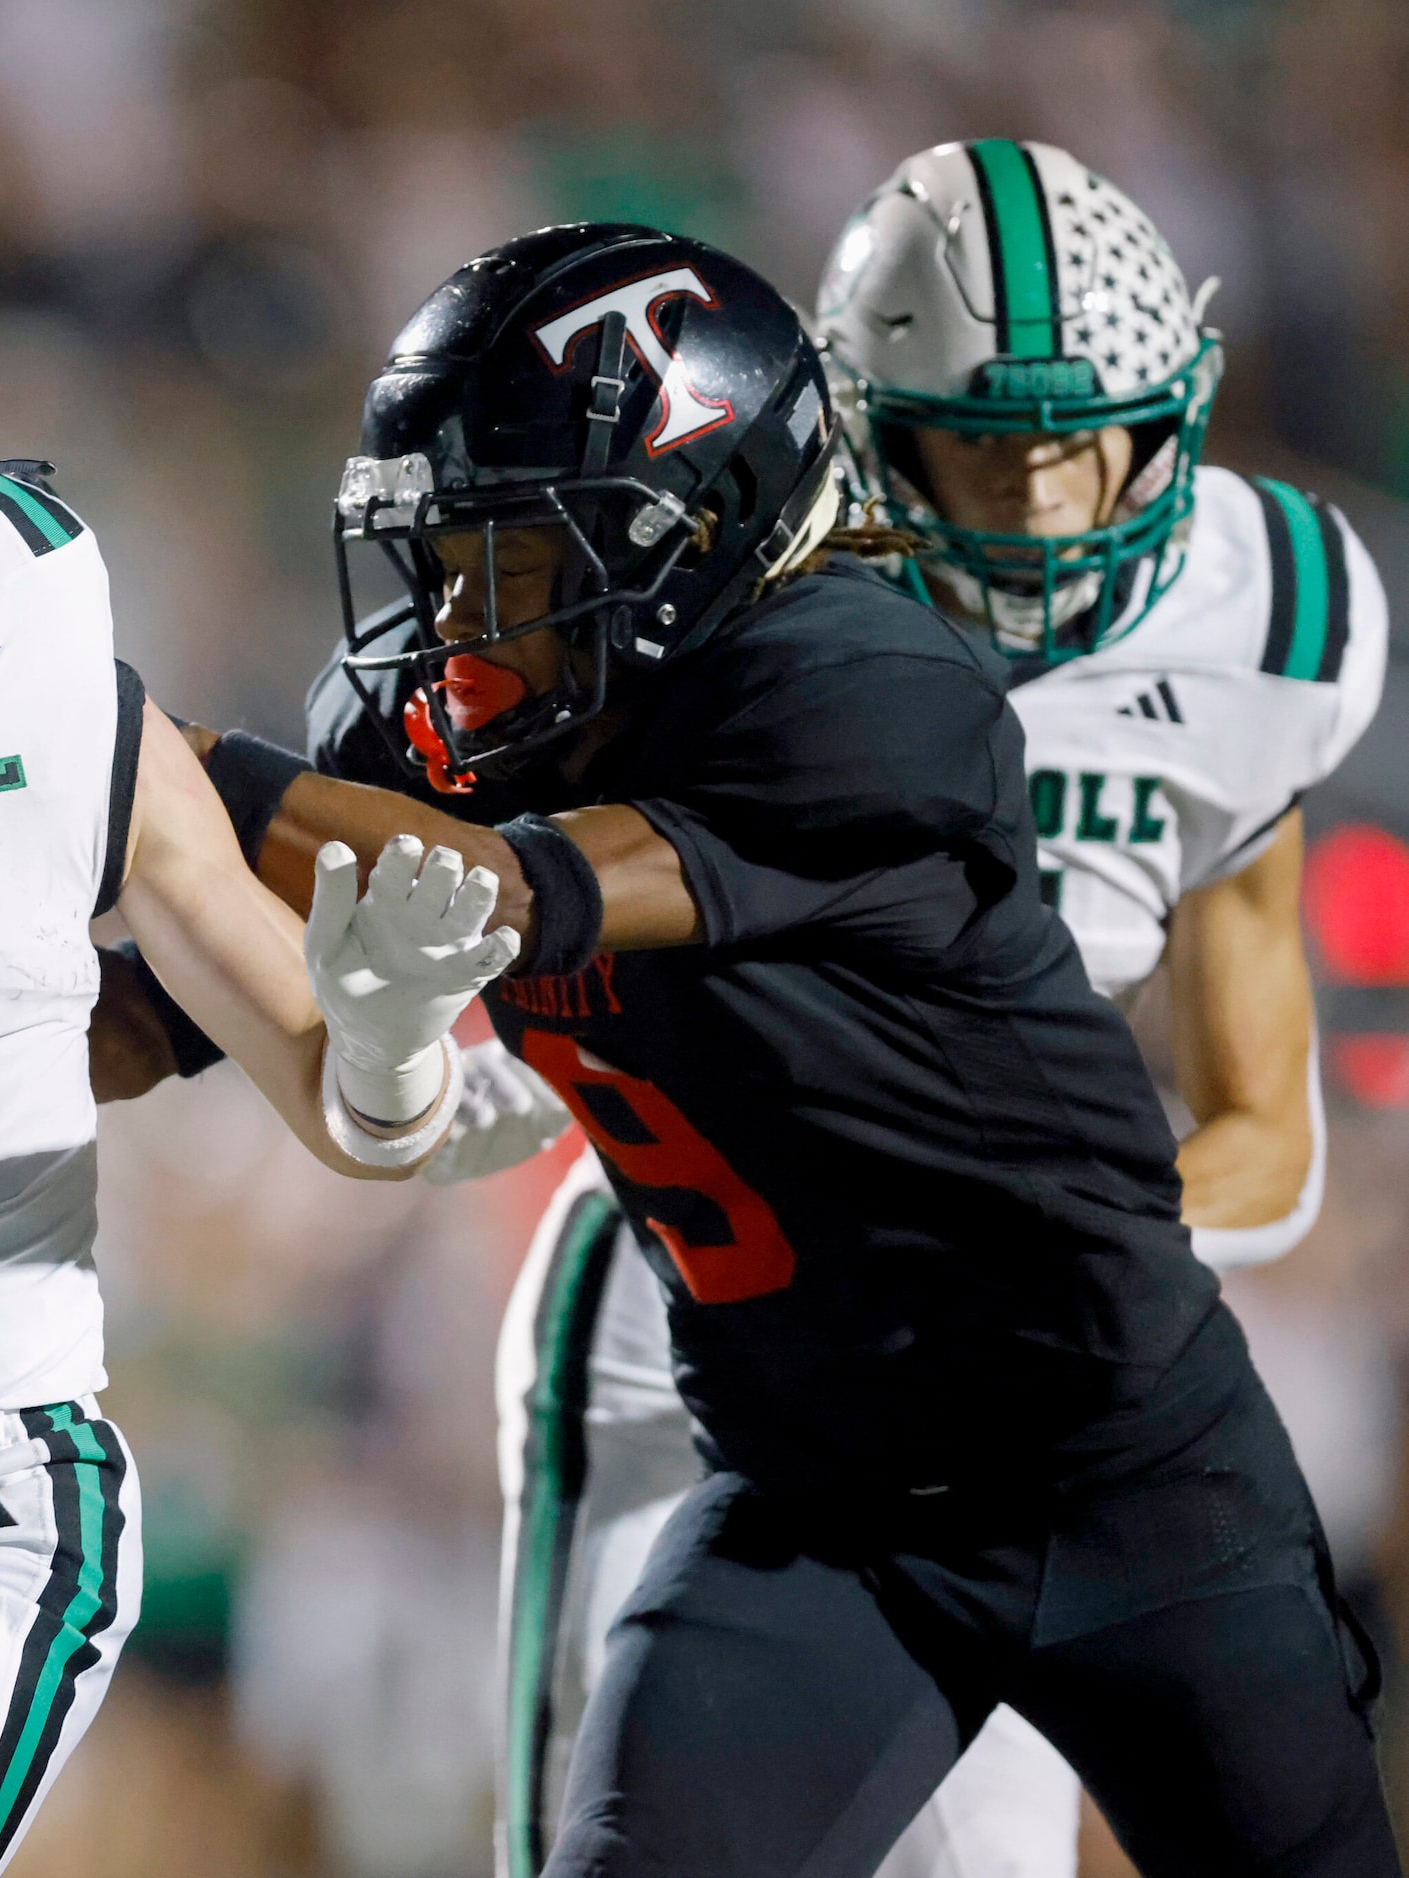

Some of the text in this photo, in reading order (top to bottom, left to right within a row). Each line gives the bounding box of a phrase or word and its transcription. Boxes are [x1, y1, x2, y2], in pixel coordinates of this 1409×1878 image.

[531, 261, 735, 458] T
[1028, 769, 1166, 843] OLL
[522, 1028, 798, 1304] 9
